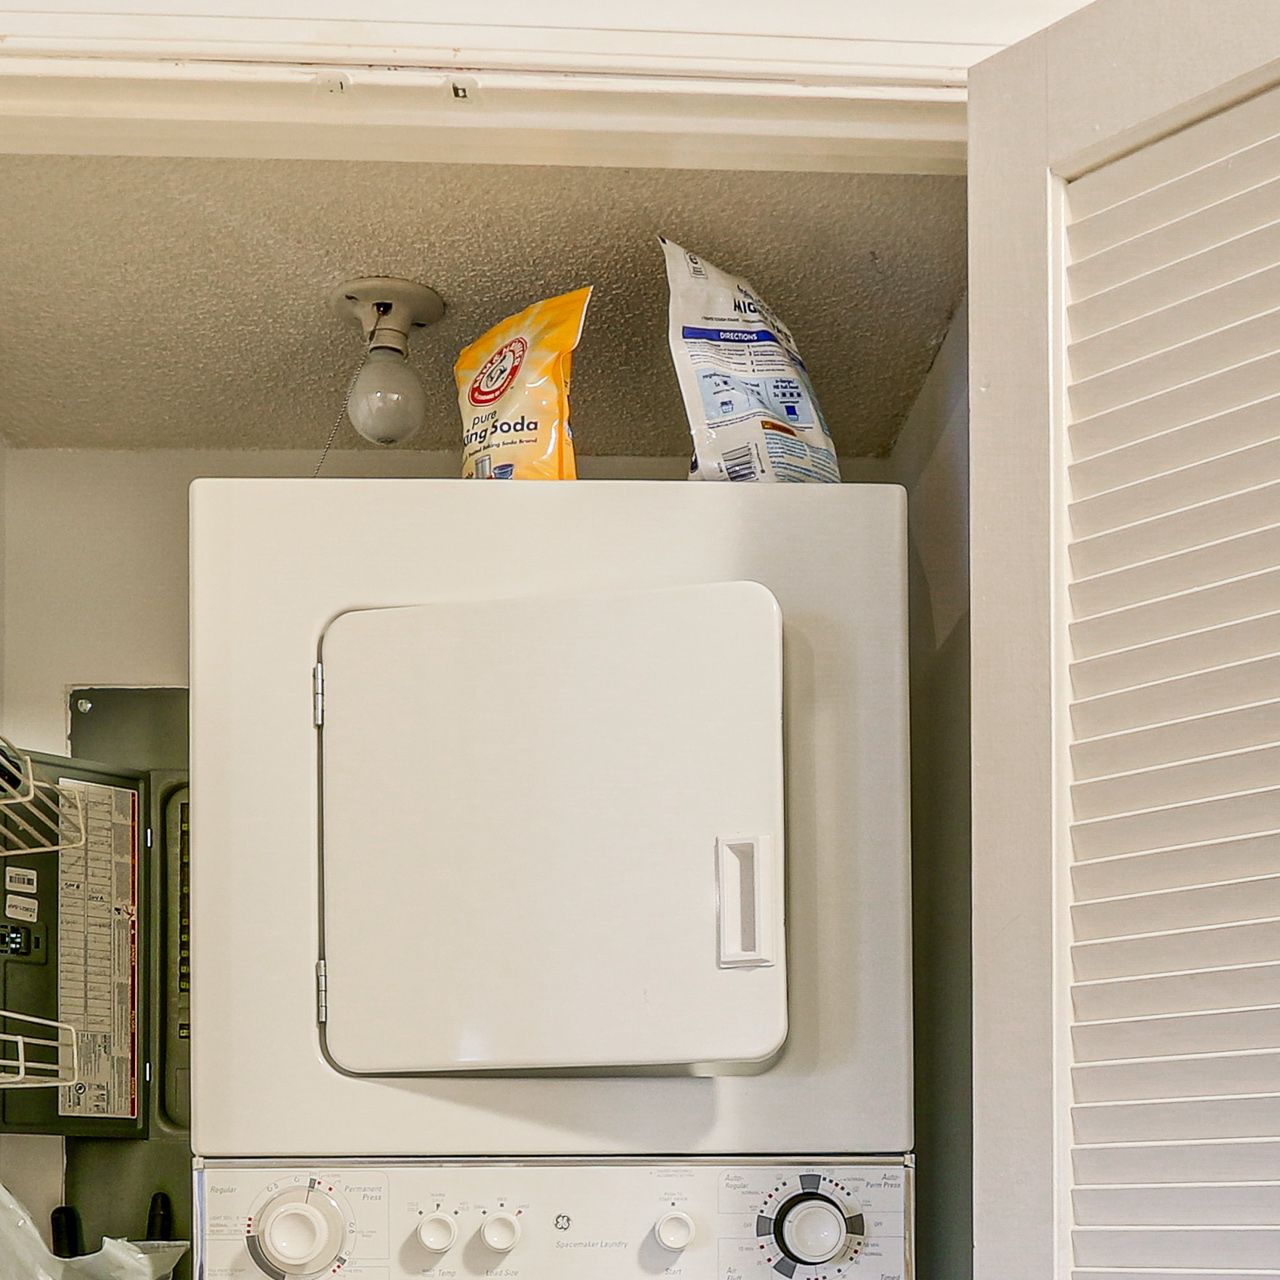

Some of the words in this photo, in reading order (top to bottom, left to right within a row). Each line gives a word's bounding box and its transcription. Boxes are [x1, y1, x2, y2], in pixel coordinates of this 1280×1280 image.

[720, 331, 758, 341] DIRECTIONS
[471, 410, 498, 430] pure
[489, 415, 539, 436] Soda
[502, 439, 518, 447] Soda
[210, 1185, 238, 1195] Regular
[344, 1185, 383, 1193] Permanent
[555, 1240, 599, 1249] Spacemaker
[600, 1240, 628, 1249] Laundry
[664, 1268, 682, 1276] Start
